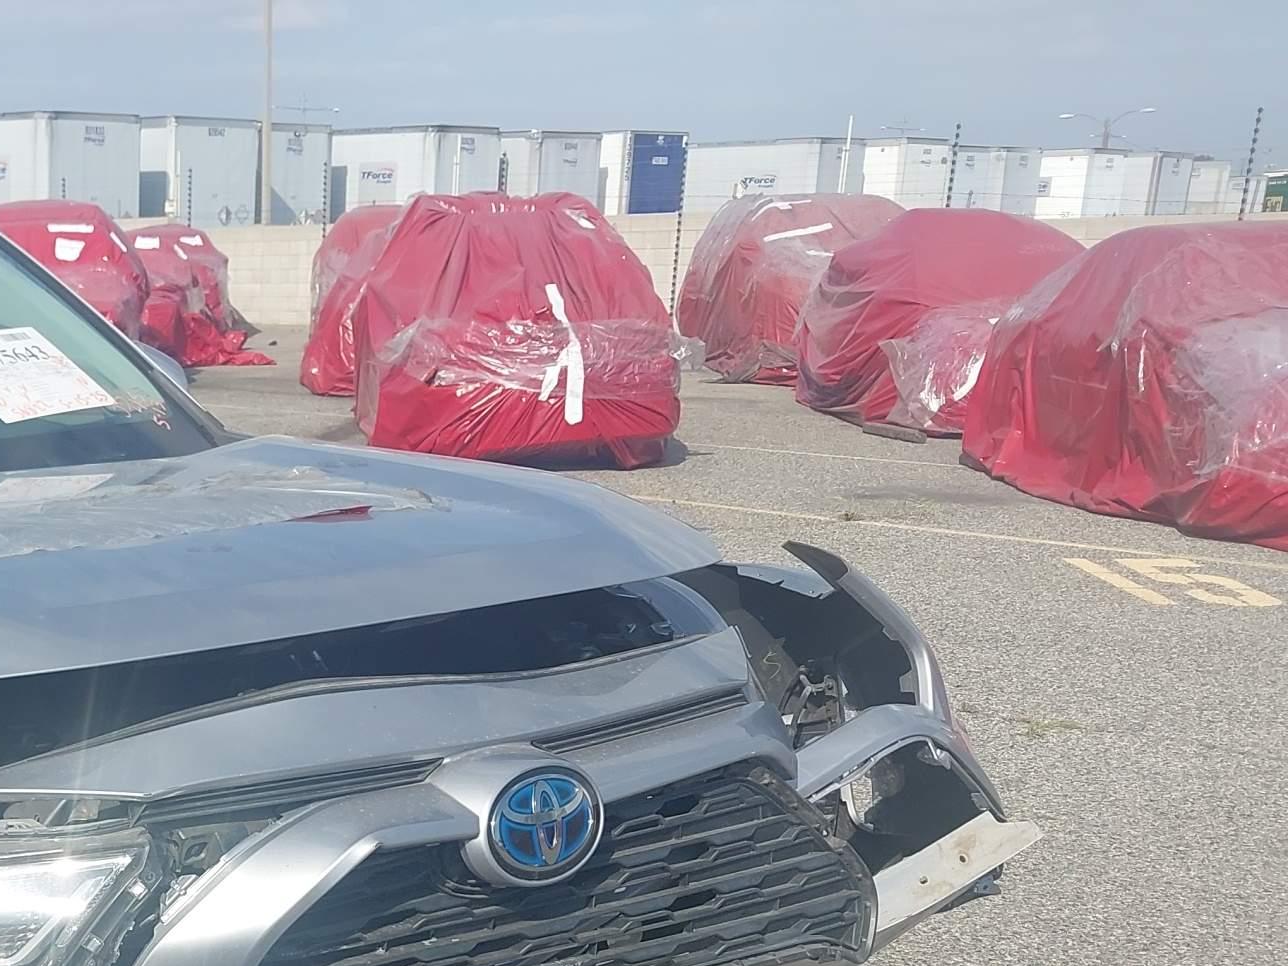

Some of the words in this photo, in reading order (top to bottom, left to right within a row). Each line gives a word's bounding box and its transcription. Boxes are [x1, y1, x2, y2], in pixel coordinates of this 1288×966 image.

[361, 171, 393, 180] TForce
[743, 176, 775, 185] TForce
[1063, 558, 1282, 607] 15
